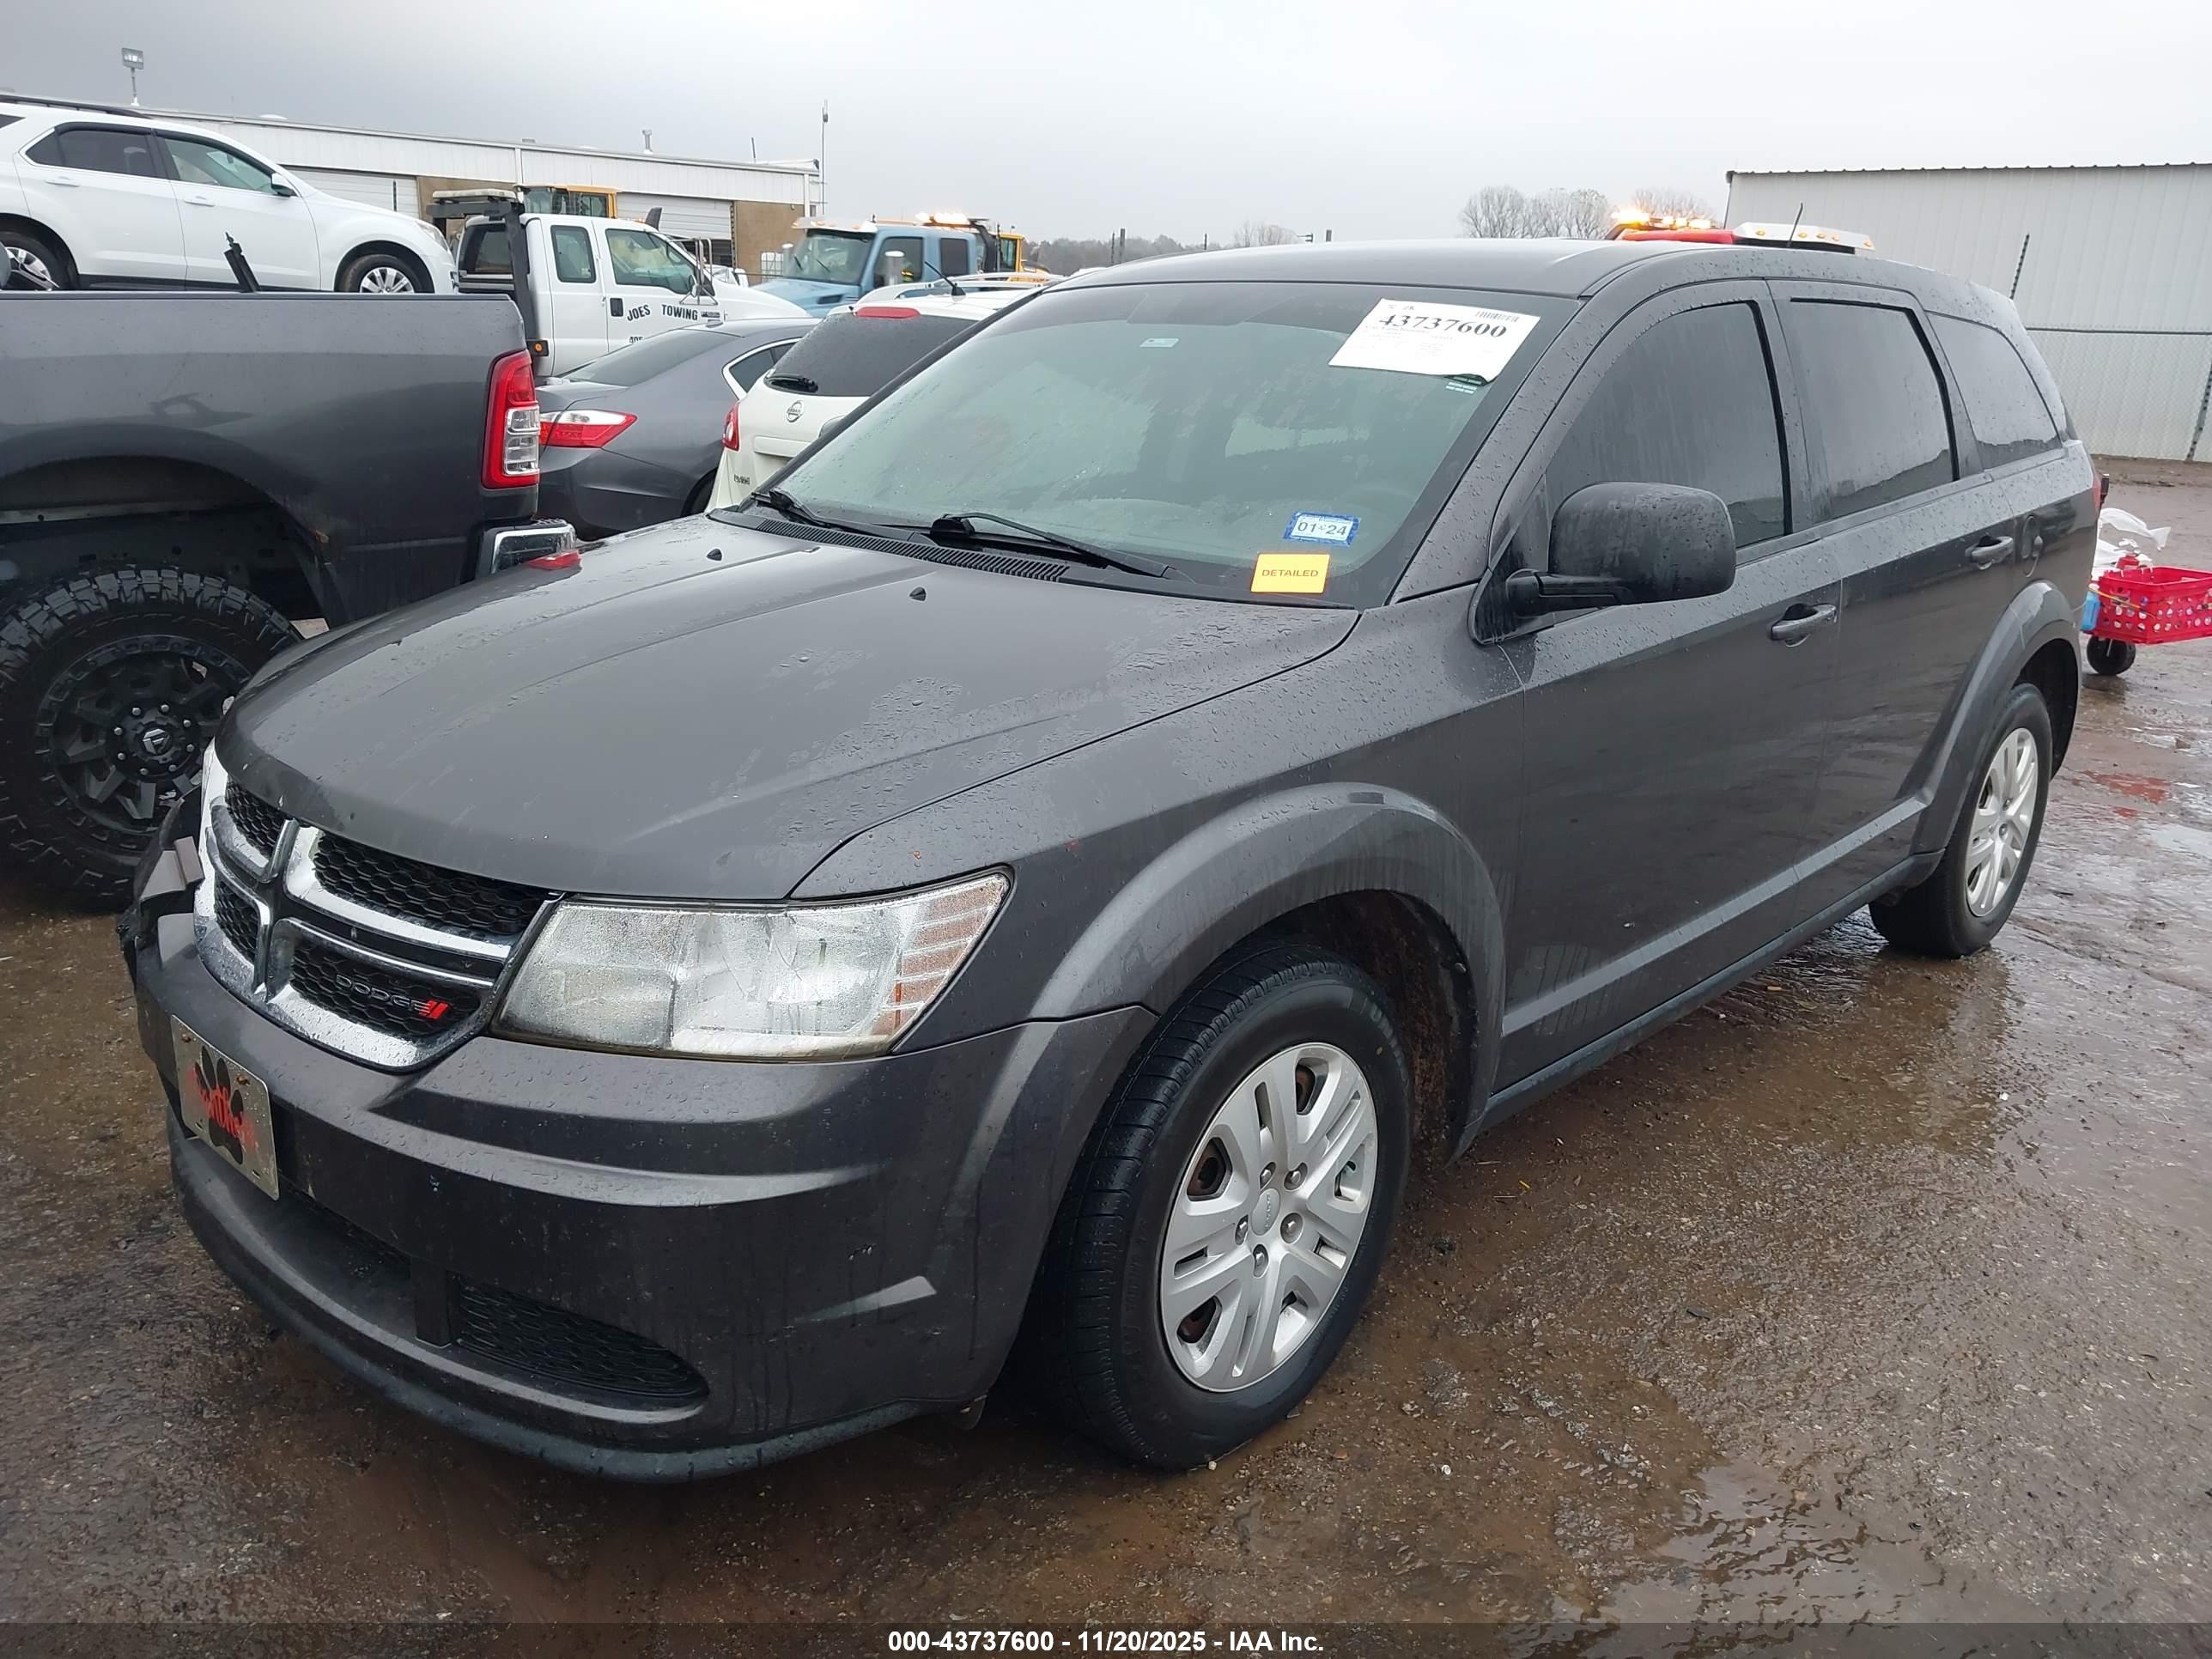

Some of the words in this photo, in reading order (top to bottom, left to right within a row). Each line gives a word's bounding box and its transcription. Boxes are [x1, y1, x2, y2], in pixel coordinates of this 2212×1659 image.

[627, 305, 651, 321] JOES
[661, 304, 698, 321] TOWING
[1379, 314, 1507, 337] 43737600
[1297, 521, 1317, 533] 01
[1326, 525, 1347, 536] 24
[336, 974, 430, 1013] DODGE
